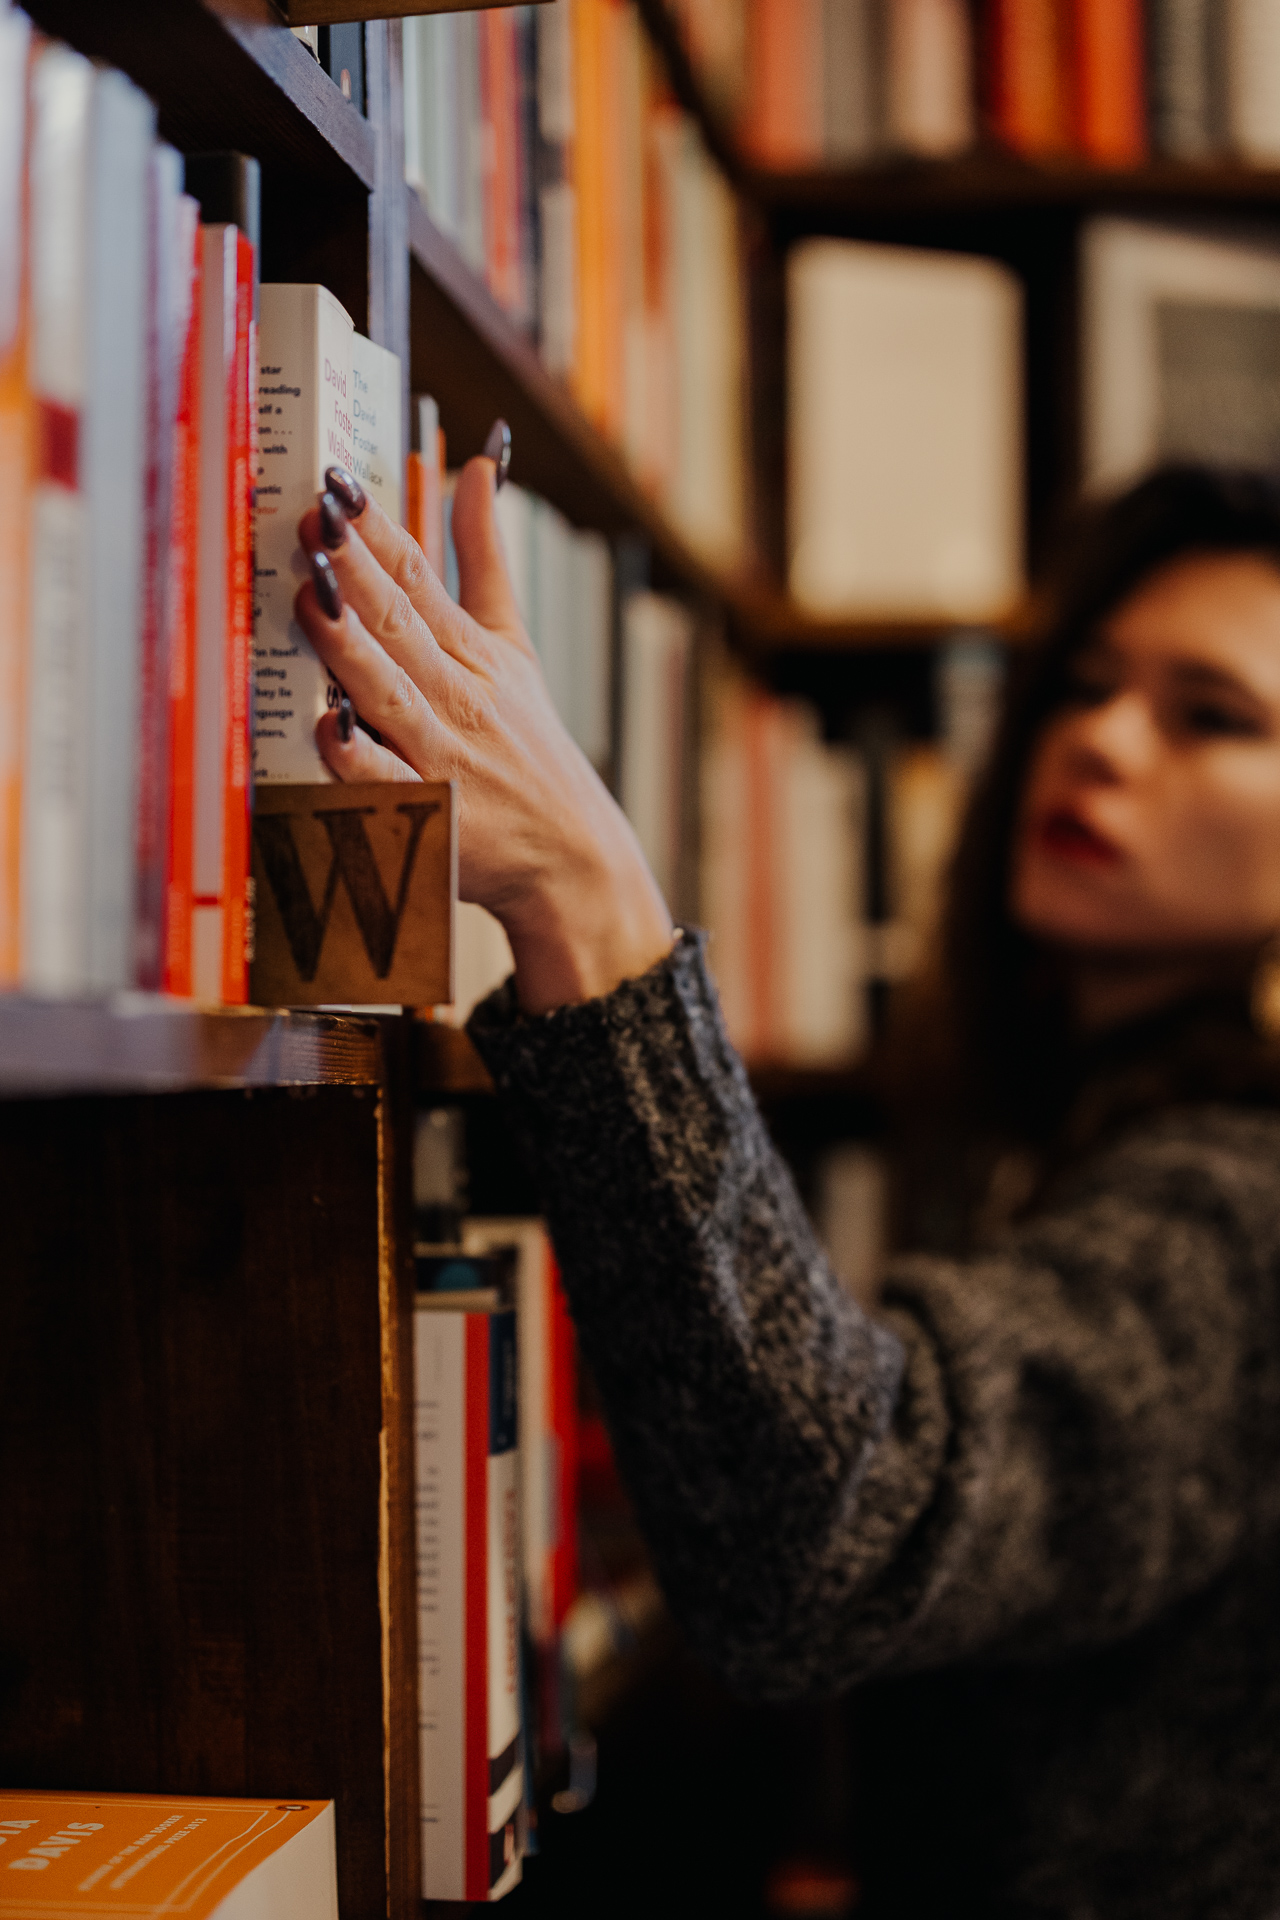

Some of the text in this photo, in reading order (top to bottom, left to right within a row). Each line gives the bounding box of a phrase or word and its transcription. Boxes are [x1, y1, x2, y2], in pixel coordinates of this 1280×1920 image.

[324, 358, 347, 399] David
[352, 369, 368, 393] The
[353, 399, 377, 427] David
[352, 428, 379, 455] Foster
[352, 456, 383, 487] Wallace
[250, 803, 442, 983] W
[8, 1822, 104, 1870] DAVIS
